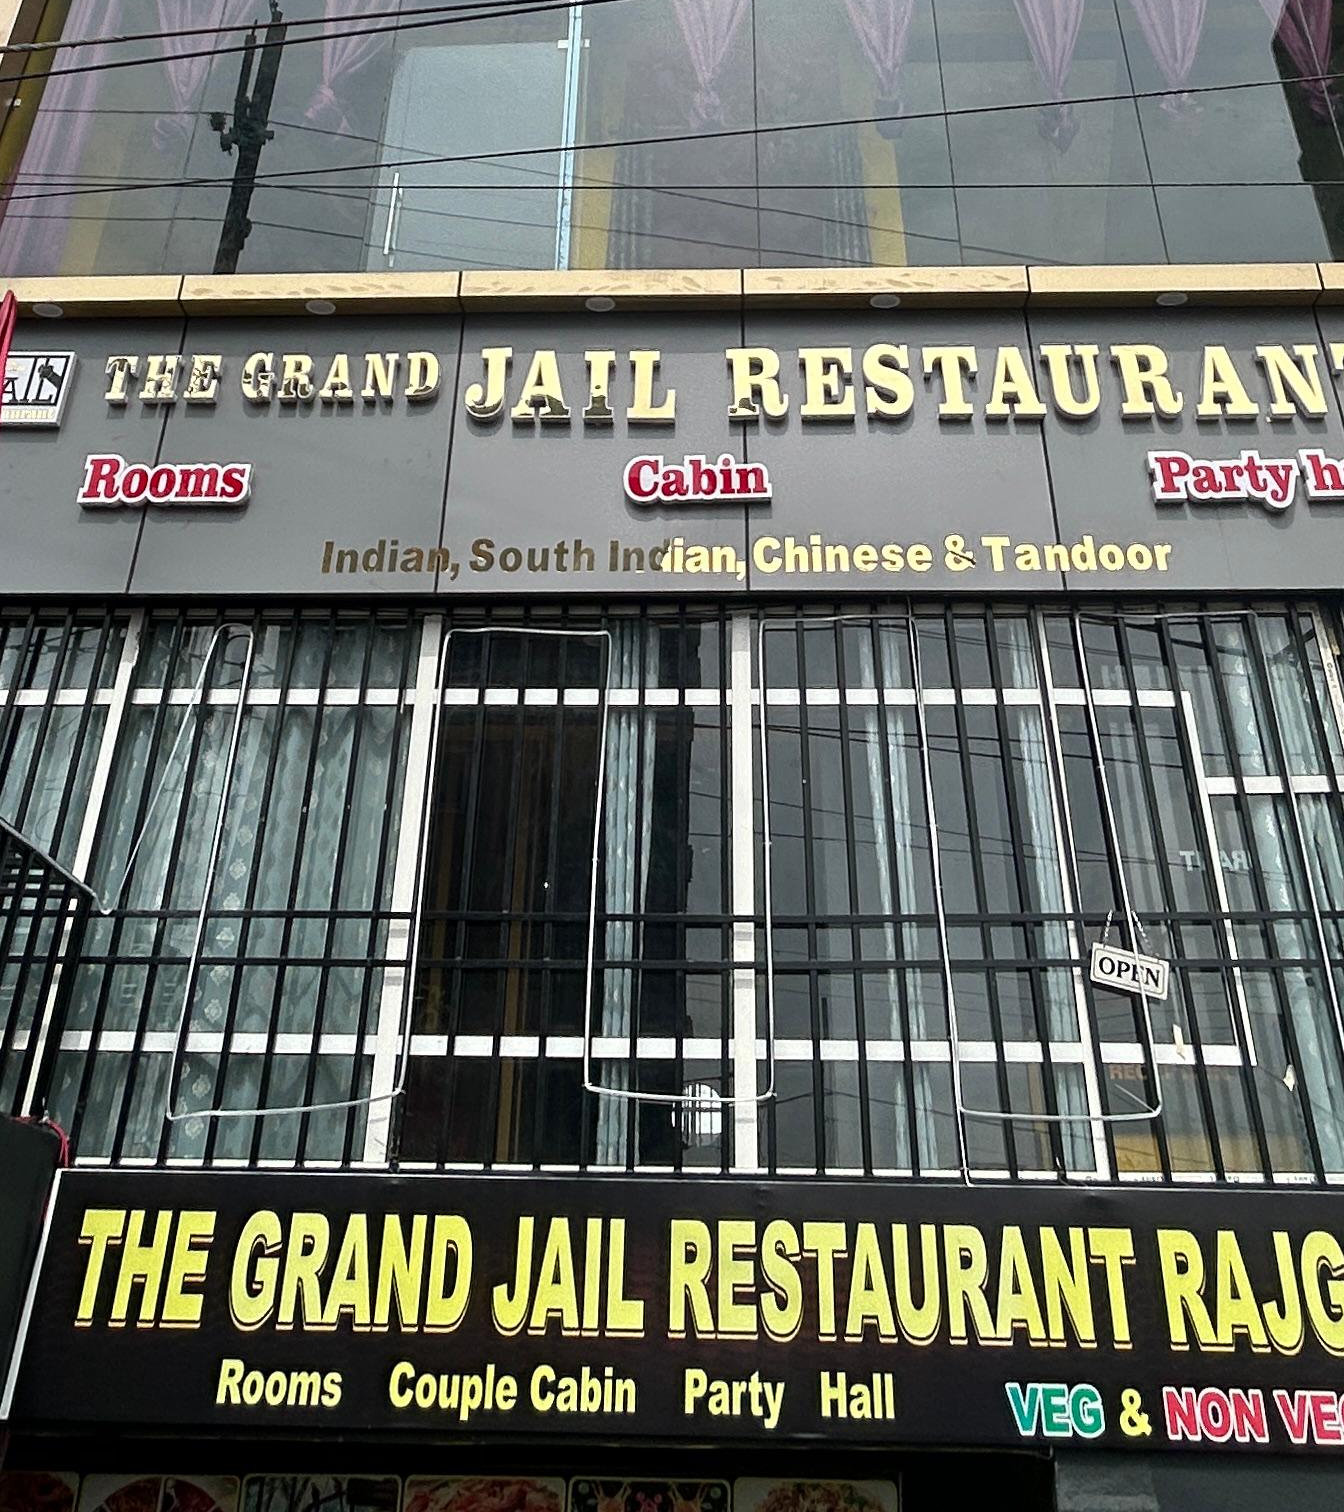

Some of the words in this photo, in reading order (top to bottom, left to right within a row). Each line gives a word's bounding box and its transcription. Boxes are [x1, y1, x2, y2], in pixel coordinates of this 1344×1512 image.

[105, 354, 223, 404] THE
[241, 351, 442, 403] GRAND
[464, 347, 677, 423] JAIL
[81, 455, 250, 506] Rooms
[623, 458, 771, 504] Cabin
[1150, 452, 1301, 510] Party
[321, 539, 460, 580] Indian,
[469, 538, 595, 572] South
[609, 537, 745, 580] Indian,
[753, 535, 934, 573] Chinese
[944, 534, 976, 572] &
[981, 535, 1172, 572] Tandoor
[1099, 956, 1160, 988] OPEN
[75, 1209, 216, 1328] THE
[231, 1211, 474, 1332] GRAND
[493, 1216, 645, 1339] JAIL
[667, 1219, 1136, 1344] RESTAURANT
[216, 1359, 343, 1407] Rooms
[389, 1362, 518, 1420] Couple
[530, 1365, 636, 1413] Cabin
[684, 1368, 786, 1429] Party
[819, 1372, 896, 1421] Hall
[1006, 1384, 1105, 1437] VEG
[1119, 1388, 1152, 1436] &
[1163, 1387, 1270, 1442] NON
